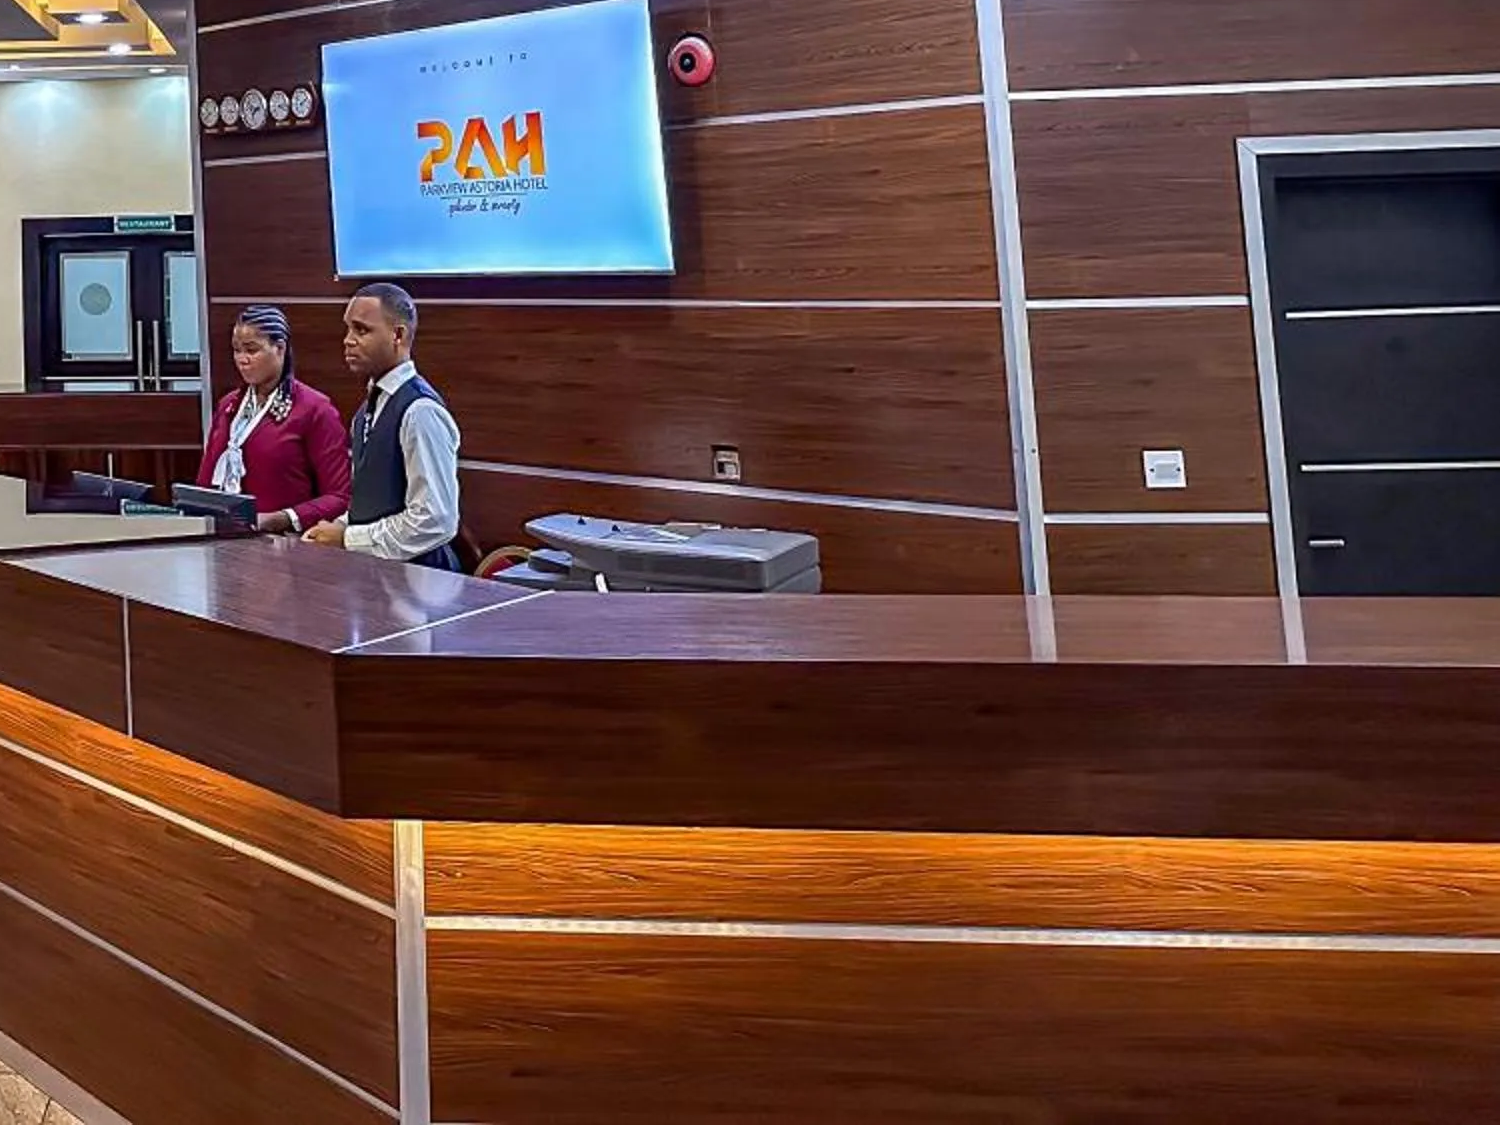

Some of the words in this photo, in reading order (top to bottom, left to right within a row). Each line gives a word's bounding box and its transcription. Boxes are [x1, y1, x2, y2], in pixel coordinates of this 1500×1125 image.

[417, 111, 545, 182] PAH
[420, 181, 466, 196] PARKVIEW
[470, 178, 512, 194] ASTORIA
[513, 176, 548, 190] HOTEL
